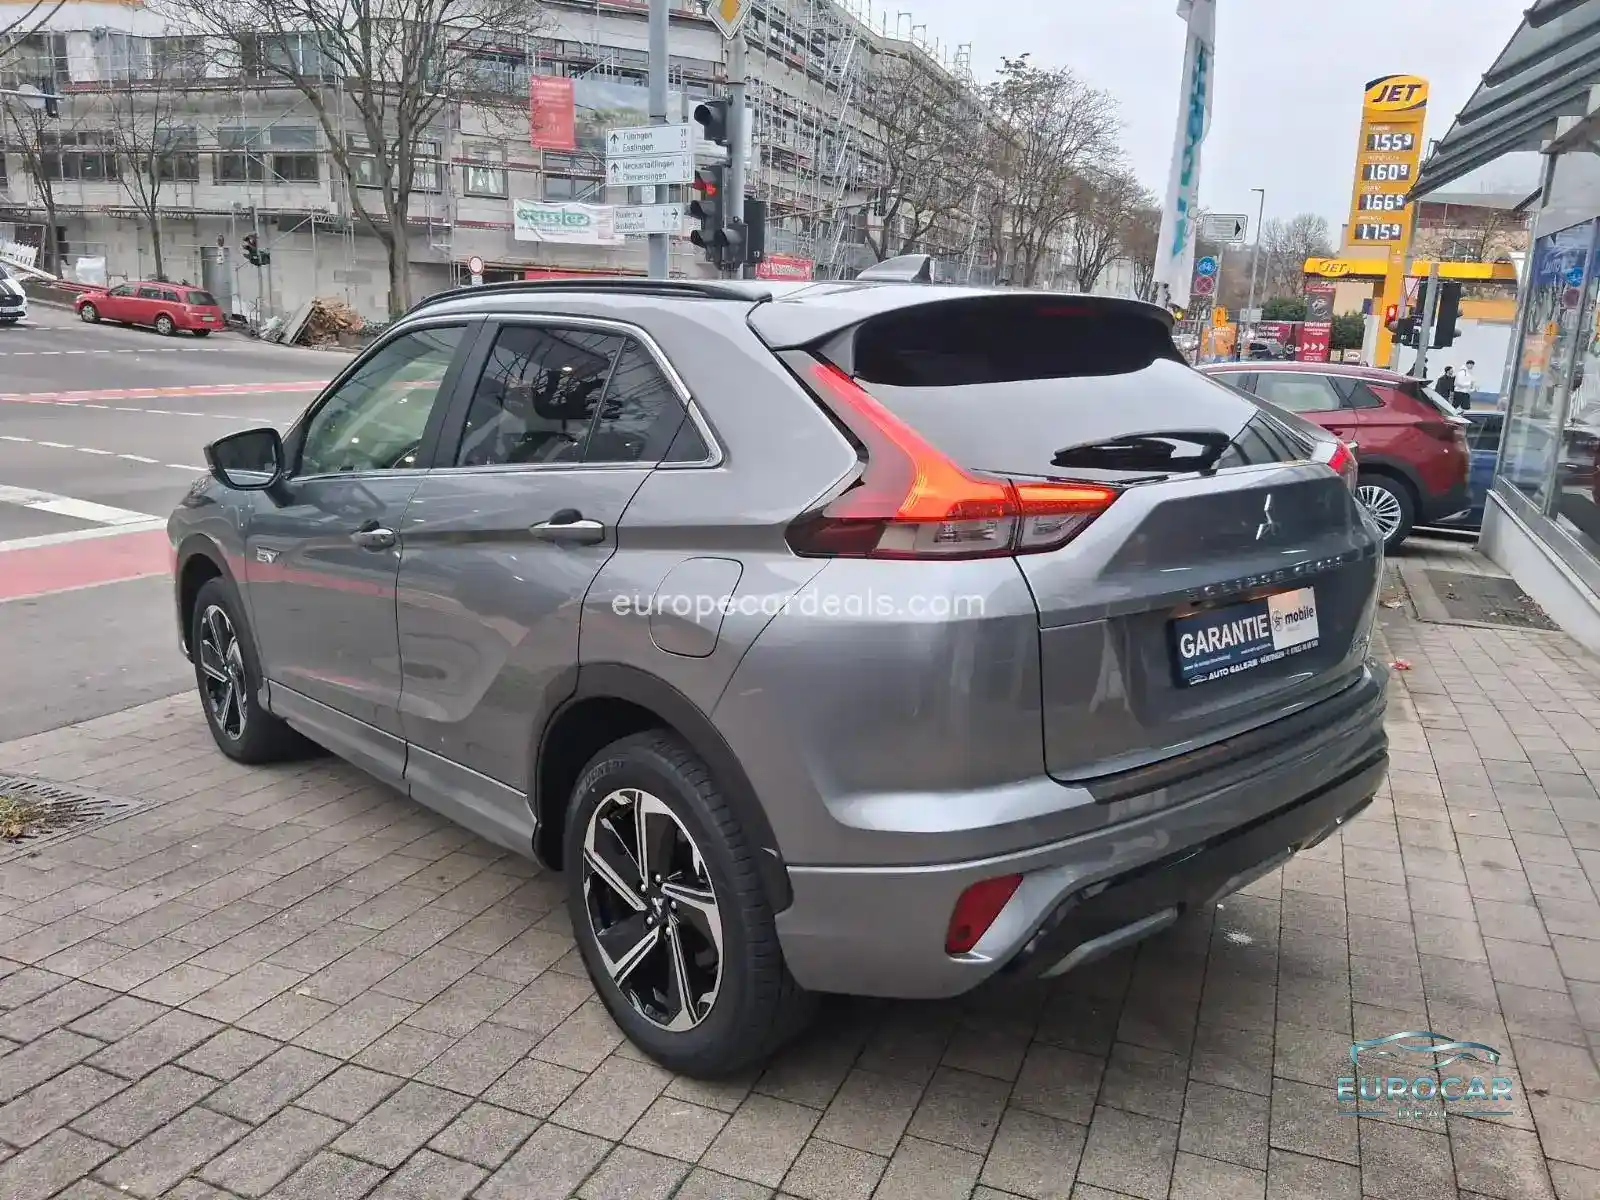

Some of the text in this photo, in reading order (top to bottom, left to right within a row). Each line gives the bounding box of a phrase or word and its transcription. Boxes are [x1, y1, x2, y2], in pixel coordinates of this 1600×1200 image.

[1372, 84, 1422, 103] JET
[1321, 263, 1348, 273] JET
[1285, 605, 1314, 625] mobile
[1180, 613, 1270, 659] GARANTIE
[1208, 666, 1229, 681] AUTO
